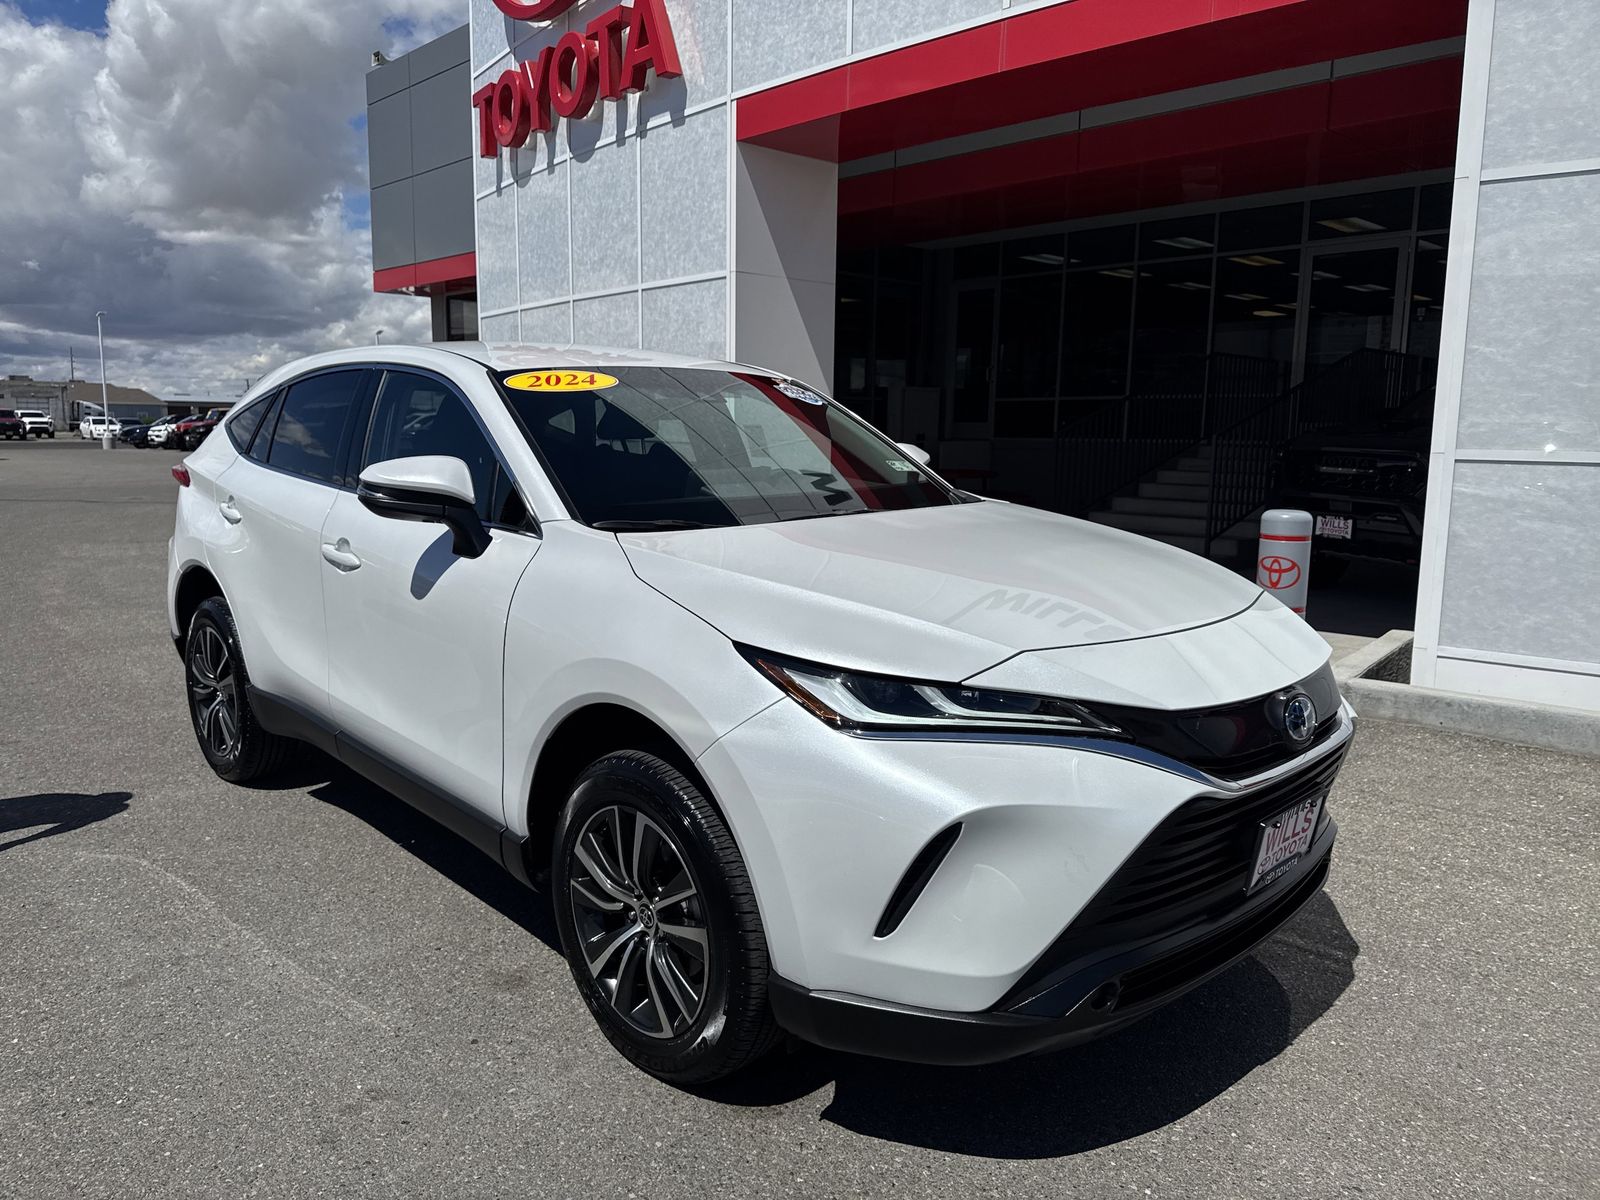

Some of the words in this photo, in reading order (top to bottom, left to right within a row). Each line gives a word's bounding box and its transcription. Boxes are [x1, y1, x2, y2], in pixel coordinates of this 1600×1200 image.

[473, 0, 683, 159] TOYOTA
[526, 373, 598, 388] 2024
[1320, 519, 1349, 529] WILLS
[1265, 807, 1315, 855] WILLS
[1271, 834, 1307, 865] TOYOTA
[1275, 858, 1298, 877] TOYOTA
